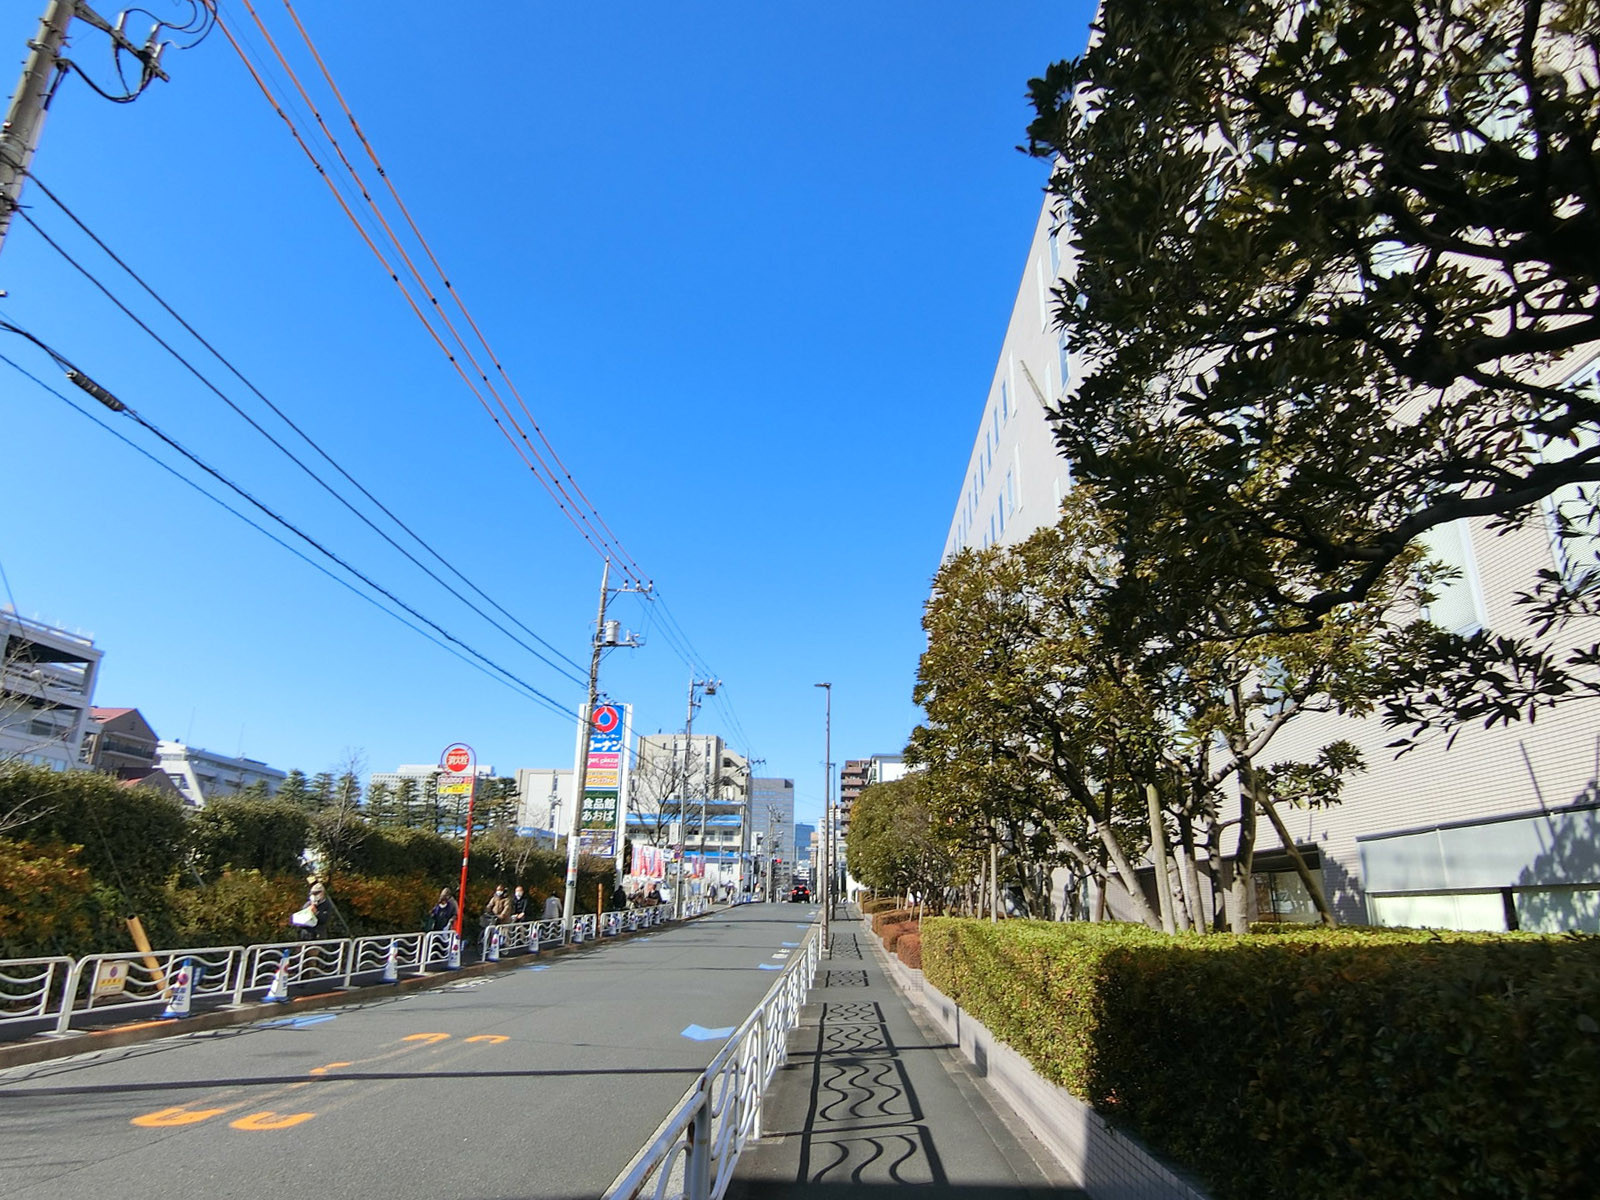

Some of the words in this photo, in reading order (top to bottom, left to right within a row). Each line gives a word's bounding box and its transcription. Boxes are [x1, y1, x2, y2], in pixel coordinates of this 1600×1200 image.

[583, 797, 616, 810] 食品館
[582, 810, 616, 822] あおば
